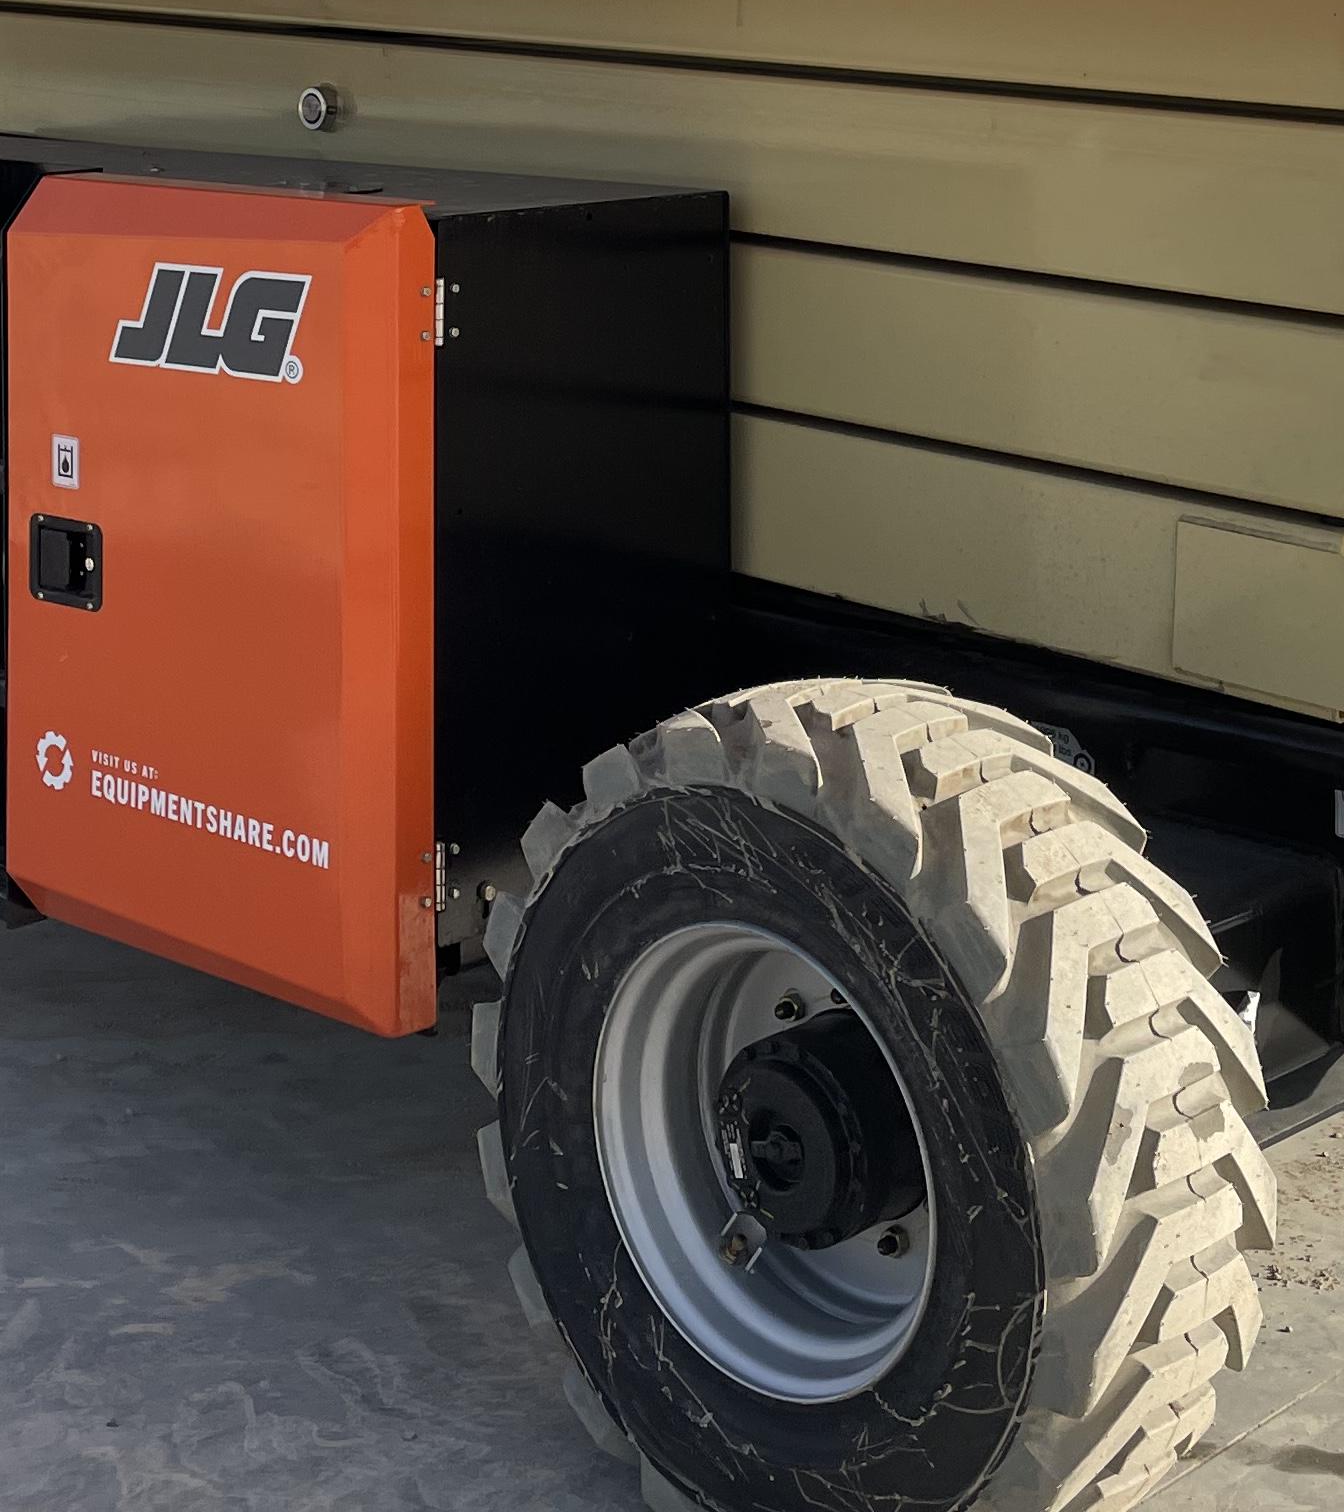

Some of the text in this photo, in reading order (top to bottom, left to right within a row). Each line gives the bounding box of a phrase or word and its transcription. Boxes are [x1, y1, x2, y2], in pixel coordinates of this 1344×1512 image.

[91, 749, 159, 780] VISIT US AT:
[91, 770, 330, 870] EQUIPMENTSHARE.COM
